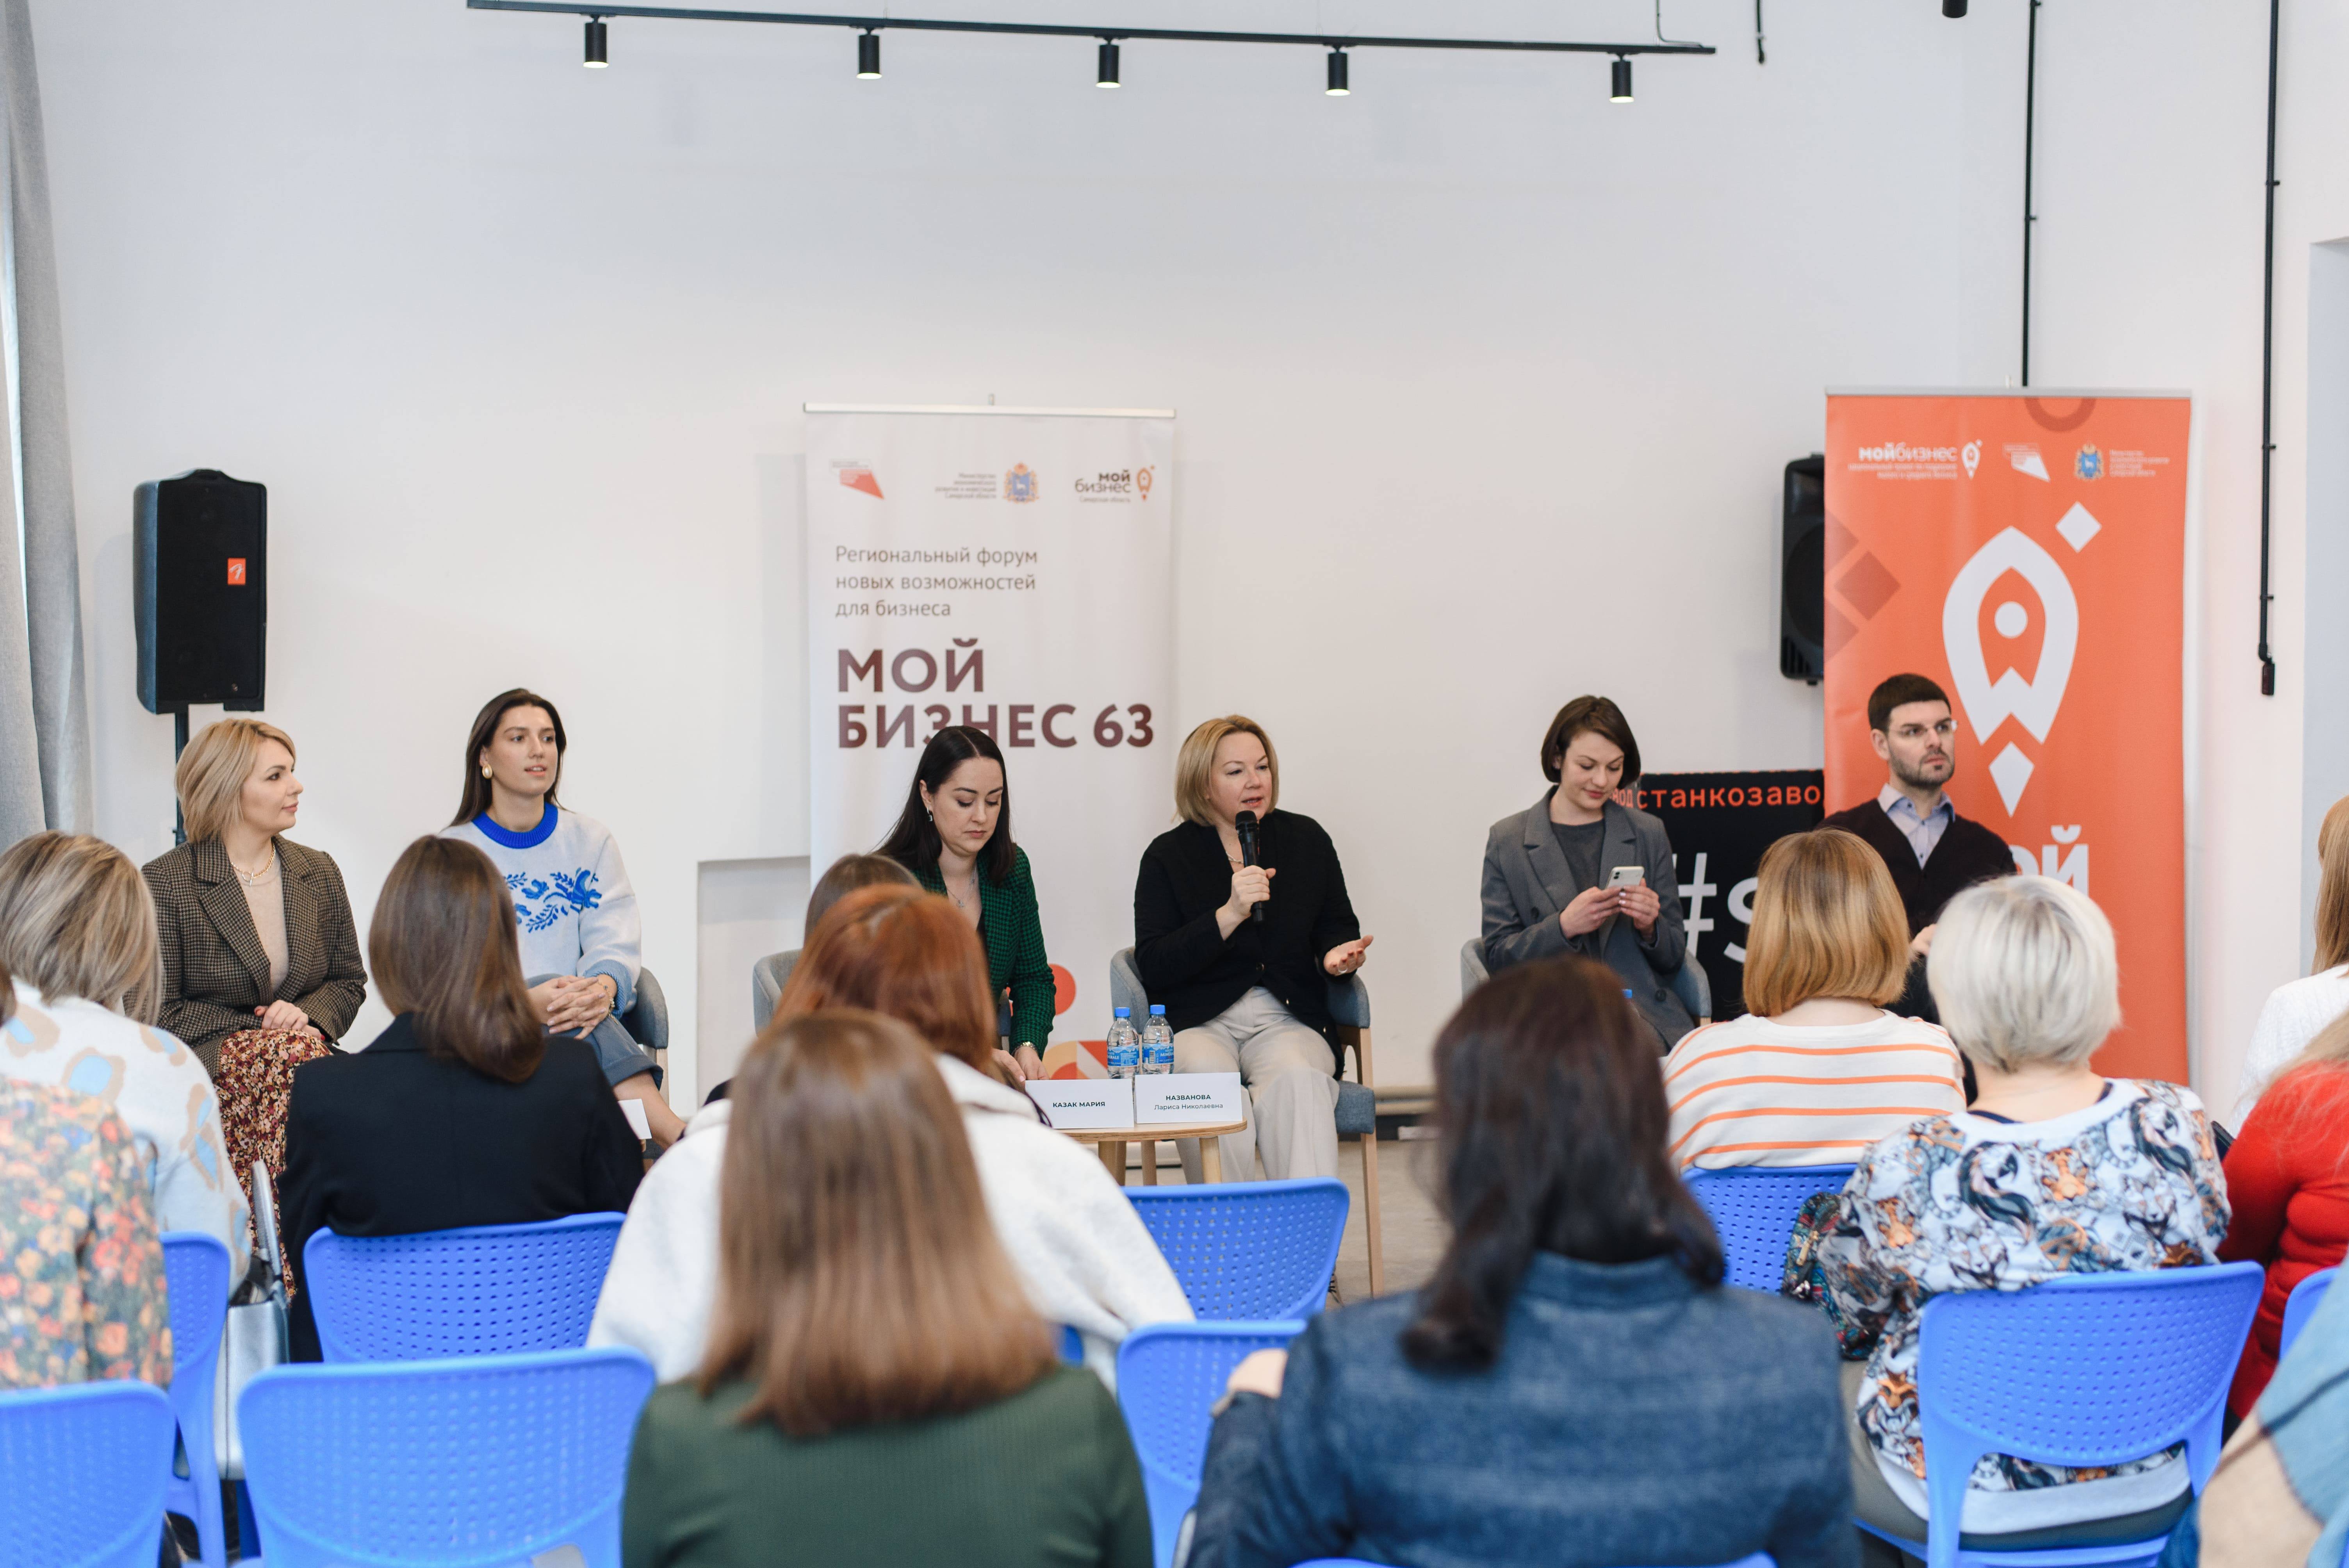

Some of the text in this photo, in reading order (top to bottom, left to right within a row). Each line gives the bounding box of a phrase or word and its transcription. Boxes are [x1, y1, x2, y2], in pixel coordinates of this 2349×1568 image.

[1099, 469, 1130, 482] мой
[1075, 478, 1131, 493] бизнес
[836, 546, 1037, 567] Региональный форум
[836, 574, 1035, 590] новых возможностей
[835, 600, 951, 618] для бизнеса
[838, 638, 984, 693] МОЙ
[1093, 704, 1154, 748] 63
